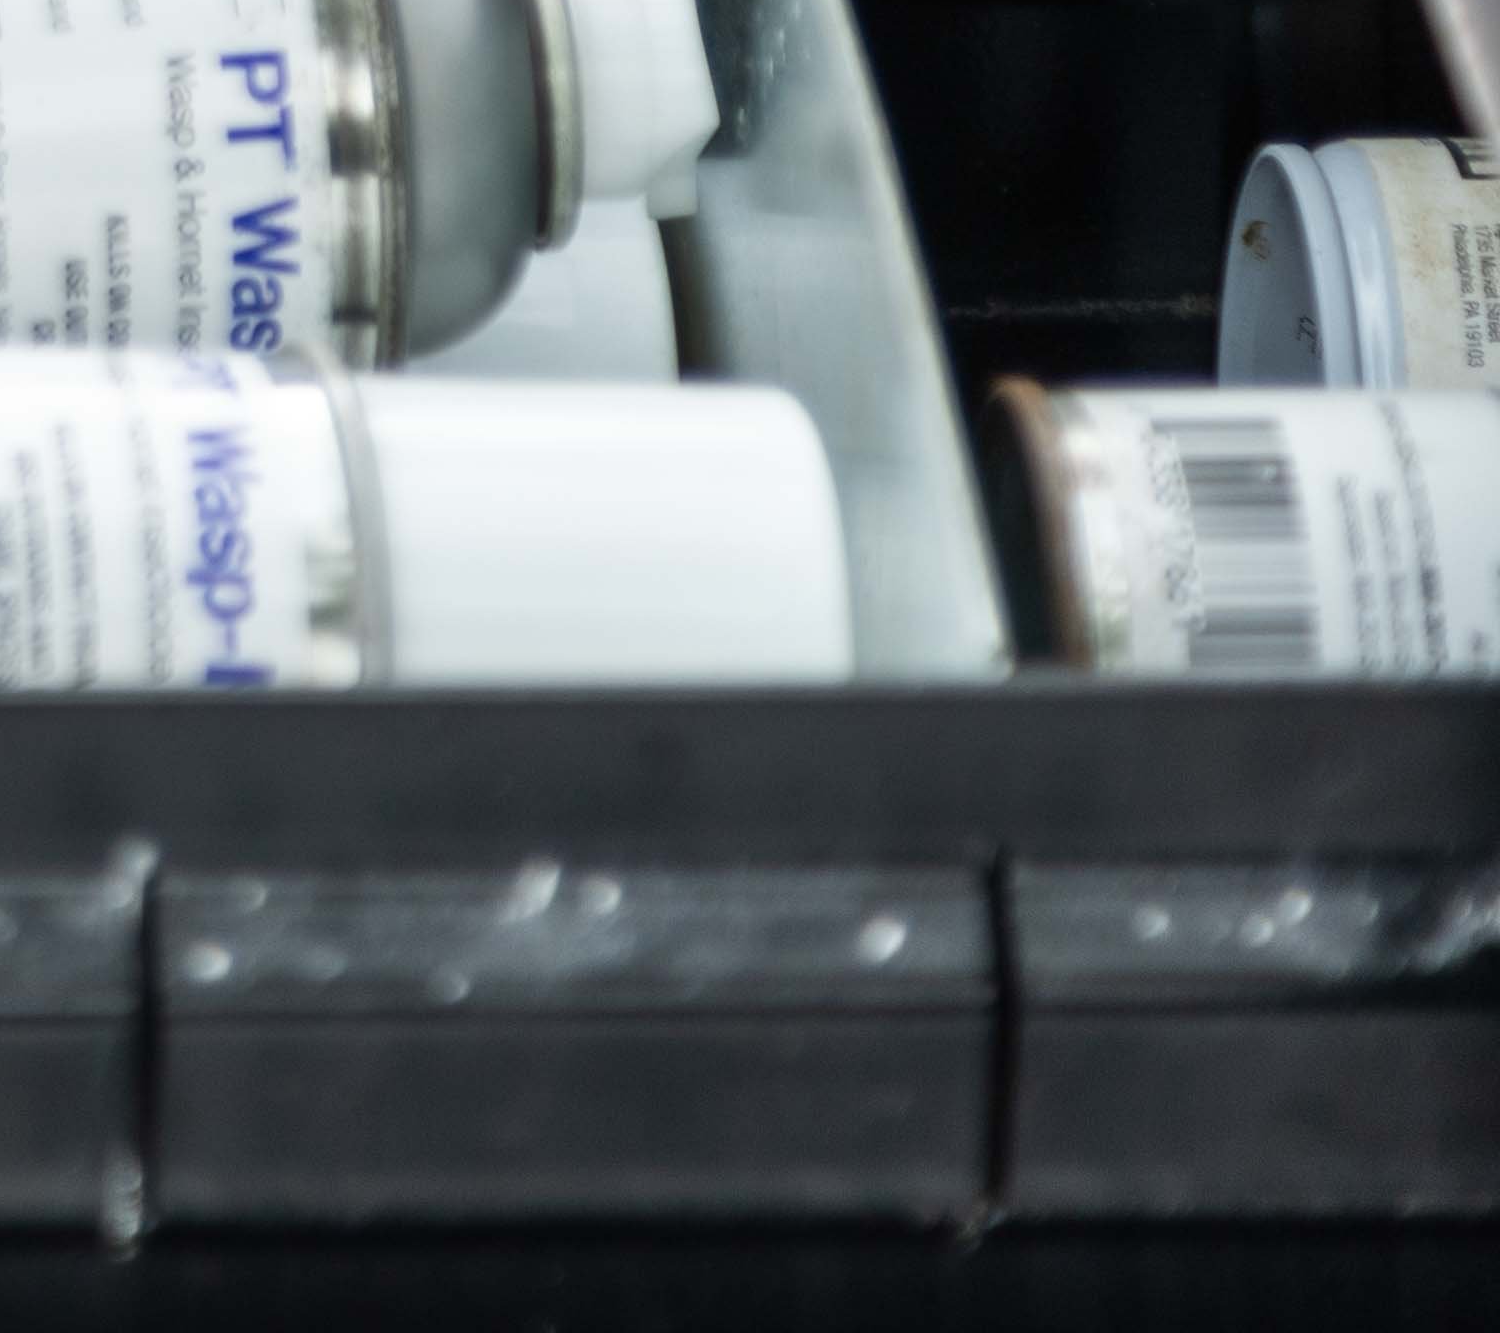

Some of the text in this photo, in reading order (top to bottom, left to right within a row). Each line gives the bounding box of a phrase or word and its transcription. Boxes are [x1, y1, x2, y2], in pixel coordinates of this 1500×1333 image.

[166, 52, 197, 149] Wasp
[175, 159, 205, 181] &
[176, 192, 207, 297] Hornet
[1462, 300, 1482, 320] PA
[1466, 323, 1485, 368] 19103
